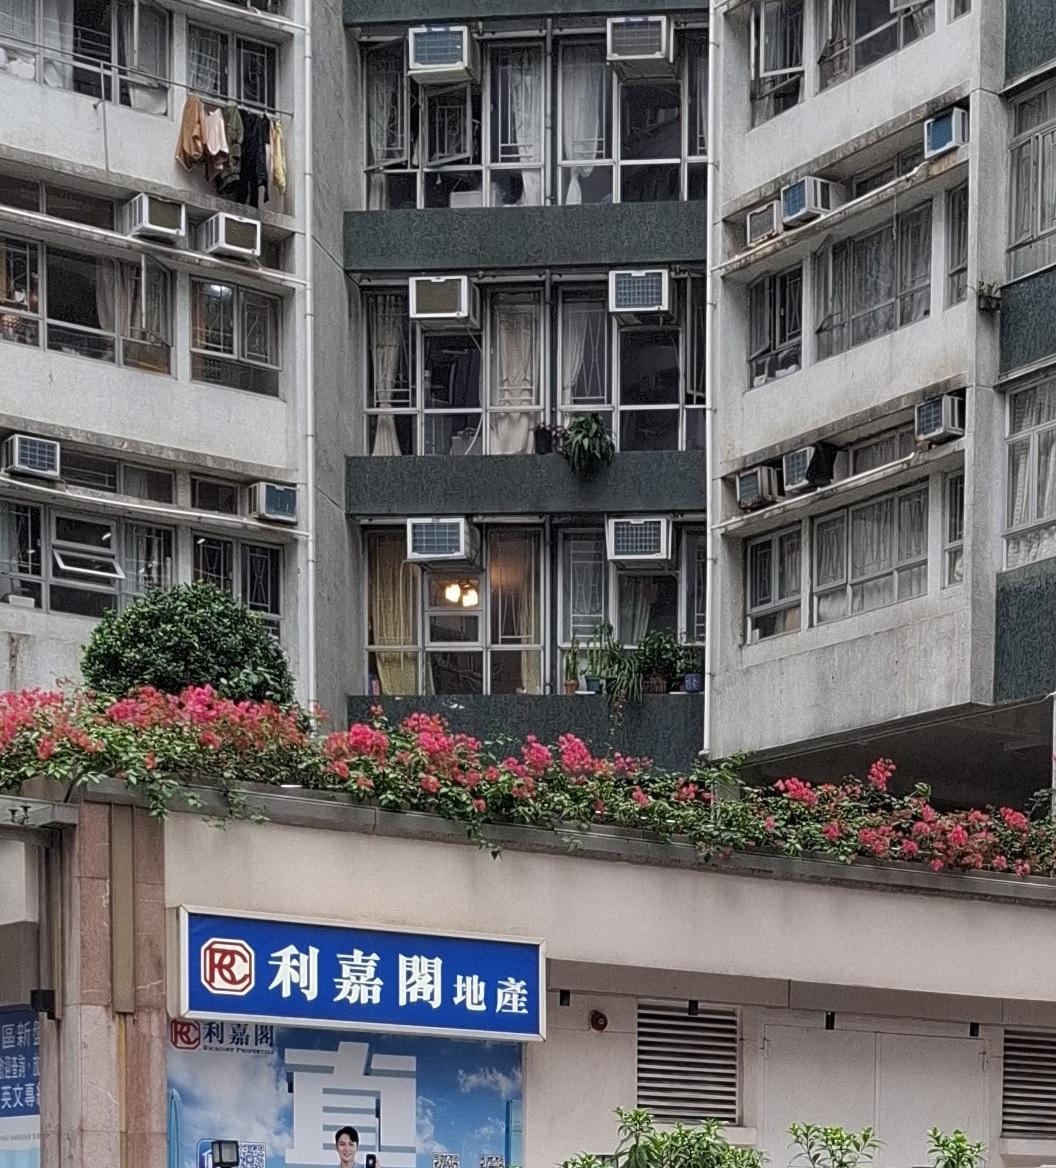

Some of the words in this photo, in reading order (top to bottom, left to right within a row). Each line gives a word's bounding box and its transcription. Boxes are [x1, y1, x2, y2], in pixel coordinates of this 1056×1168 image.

[268, 943, 529, 1015] 利嘉閣地產
[203, 1021, 274, 1047] 利嘉閣
[1, 1083, 40, 1109] 英文專
